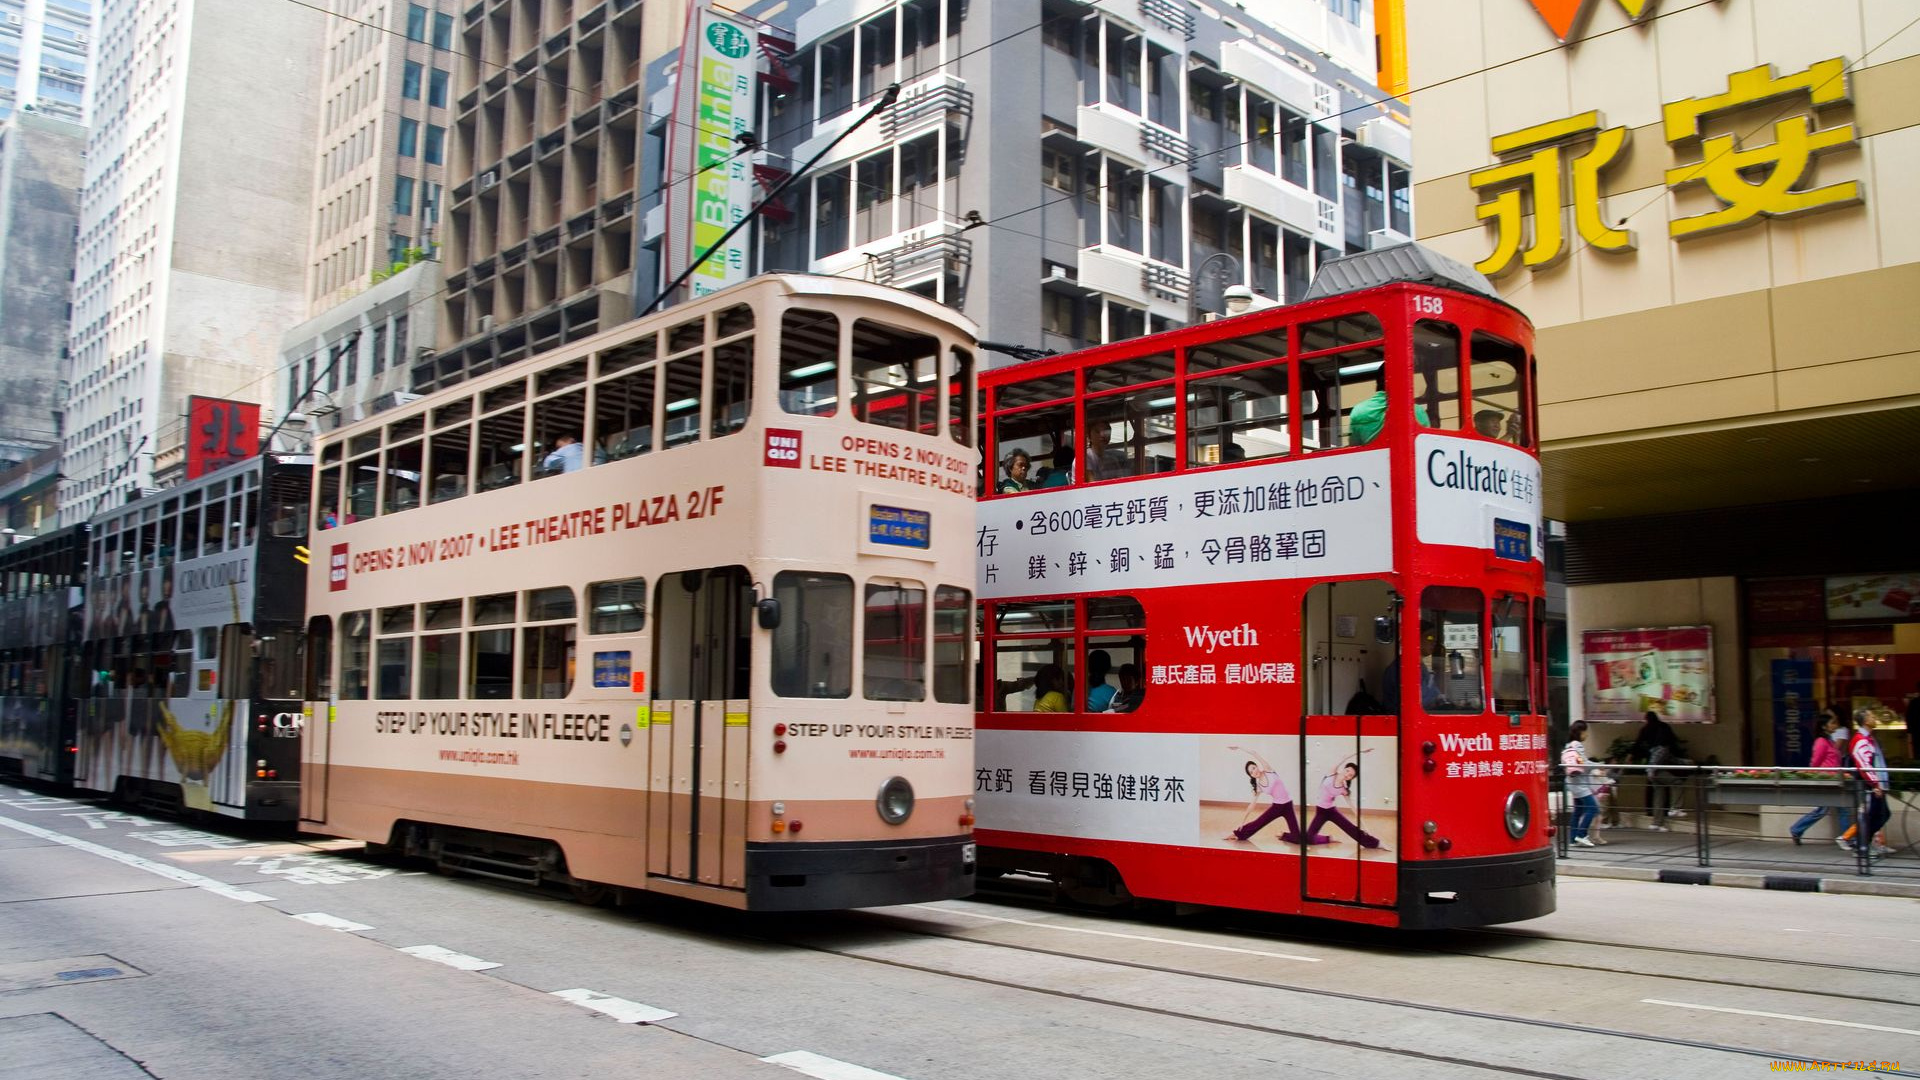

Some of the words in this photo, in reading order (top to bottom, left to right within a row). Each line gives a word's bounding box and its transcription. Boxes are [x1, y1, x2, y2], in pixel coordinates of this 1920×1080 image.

[702, 65, 733, 228] Bauhinia
[1470, 56, 1864, 277] 永安
[1412, 294, 1443, 315] 158
[767, 449, 798, 461] QLO
[769, 436, 798, 448] UNI
[841, 435, 899, 459] OPENS
[904, 446, 912, 461] 2
[916, 449, 944, 467] NOV
[946, 456, 969, 476] 2007
[810, 454, 847, 473] LEE
[854, 459, 926, 486] THEATRE
[930, 473, 965, 496] PLAZA
[1427, 449, 1507, 496] Caltrate
[354, 547, 393, 574] OPENS
[397, 546, 405, 568] 2
[409, 540, 437, 566] NOV
[440, 533, 475, 561] 2007
[490, 524, 520, 552] LEE
[525, 507, 606, 547] THEATRE
[612, 494, 680, 532] PLAZA
[687, 485, 725, 520] 2/F
[977, 525, 999, 559] 存
[180, 559, 248, 594] CROCODILE
[1183, 623, 1259, 659] Wyeth
[1151, 664, 1216, 686] 惠氏產品
[1225, 663, 1295, 686] 信心保證
[376, 711, 405, 734] STEP
[409, 711, 428, 735] UP
[430, 711, 468, 736] YOUR
[471, 712, 518, 738] STYLE
[522, 713, 538, 739] IN
[542, 714, 610, 742] FLEECE
[788, 723, 829, 737] STEP
[833, 724, 853, 737] UP
[856, 725, 895, 738] YOUR
[899, 725, 932, 739] STYLE
[935, 727, 943, 739] IN
[439, 748, 520, 766] www.uniqlo.com.hk
[1438, 733, 1494, 757] Wyeth
[1028, 770, 1185, 803] 看得見強健將來
